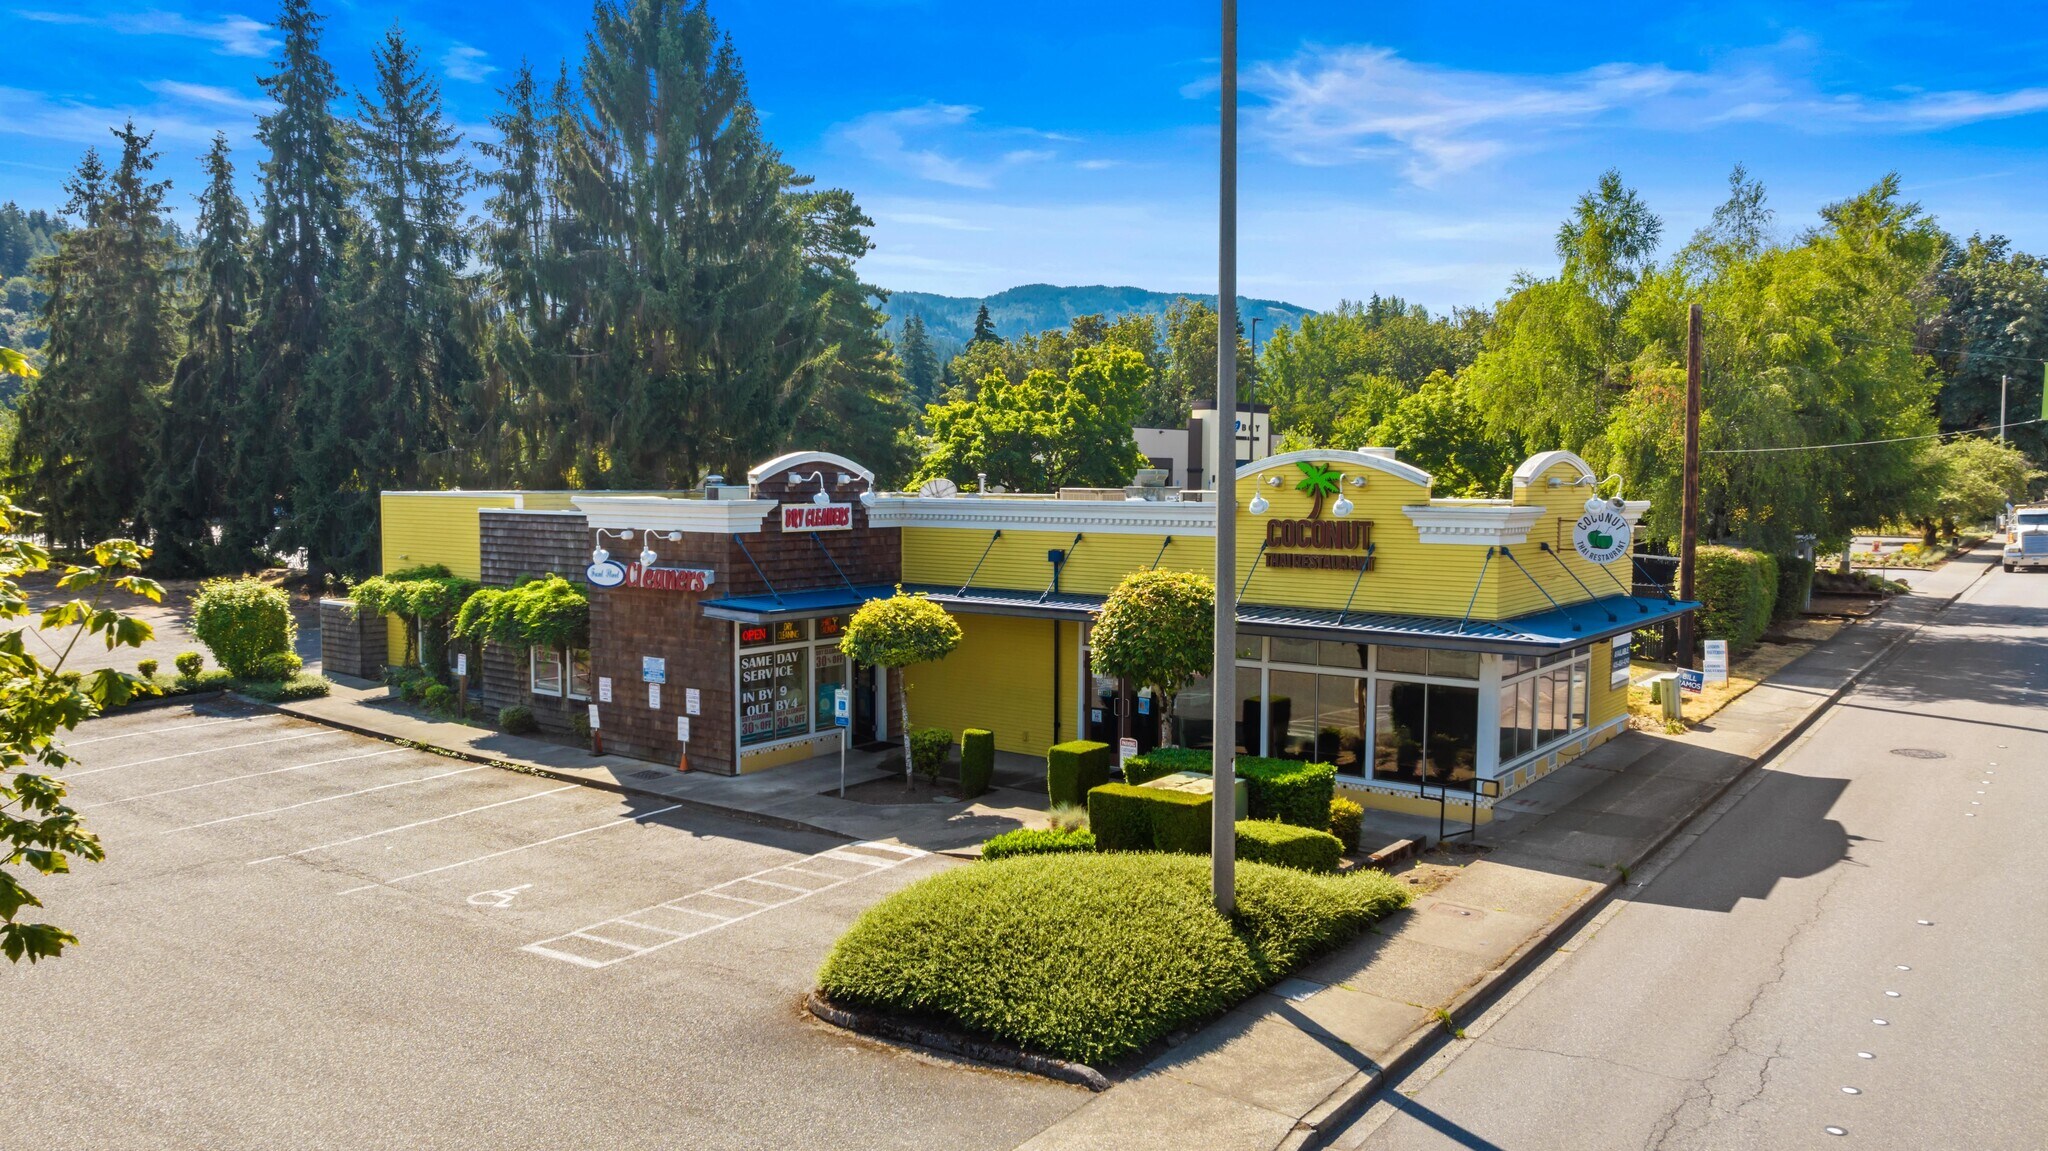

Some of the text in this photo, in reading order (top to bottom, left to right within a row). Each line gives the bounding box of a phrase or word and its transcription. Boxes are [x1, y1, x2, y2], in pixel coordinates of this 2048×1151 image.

[785, 507, 850, 528] DRY CLEANERS
[1577, 513, 1626, 530] COCONUT
[1266, 519, 1375, 550] COCONUT
[1577, 541, 1626, 561] THAI RESTAURANT
[1264, 553, 1376, 571] THAI RESTAURANT
[625, 561, 706, 592] Cleaners
[742, 628, 766, 641] OPEN
[741, 651, 799, 669] SAME DAY
[832, 654, 843, 664] OFF
[743, 665, 793, 682] SERVICE
[1682, 672, 1697, 682] BILL
[1680, 680, 1701, 690] AMOS
[743, 686, 787, 703] IN BY 9
[746, 697, 798, 716] OUT BY 4
[760, 720, 771, 730] OFF
[794, 714, 806, 723] OFF
